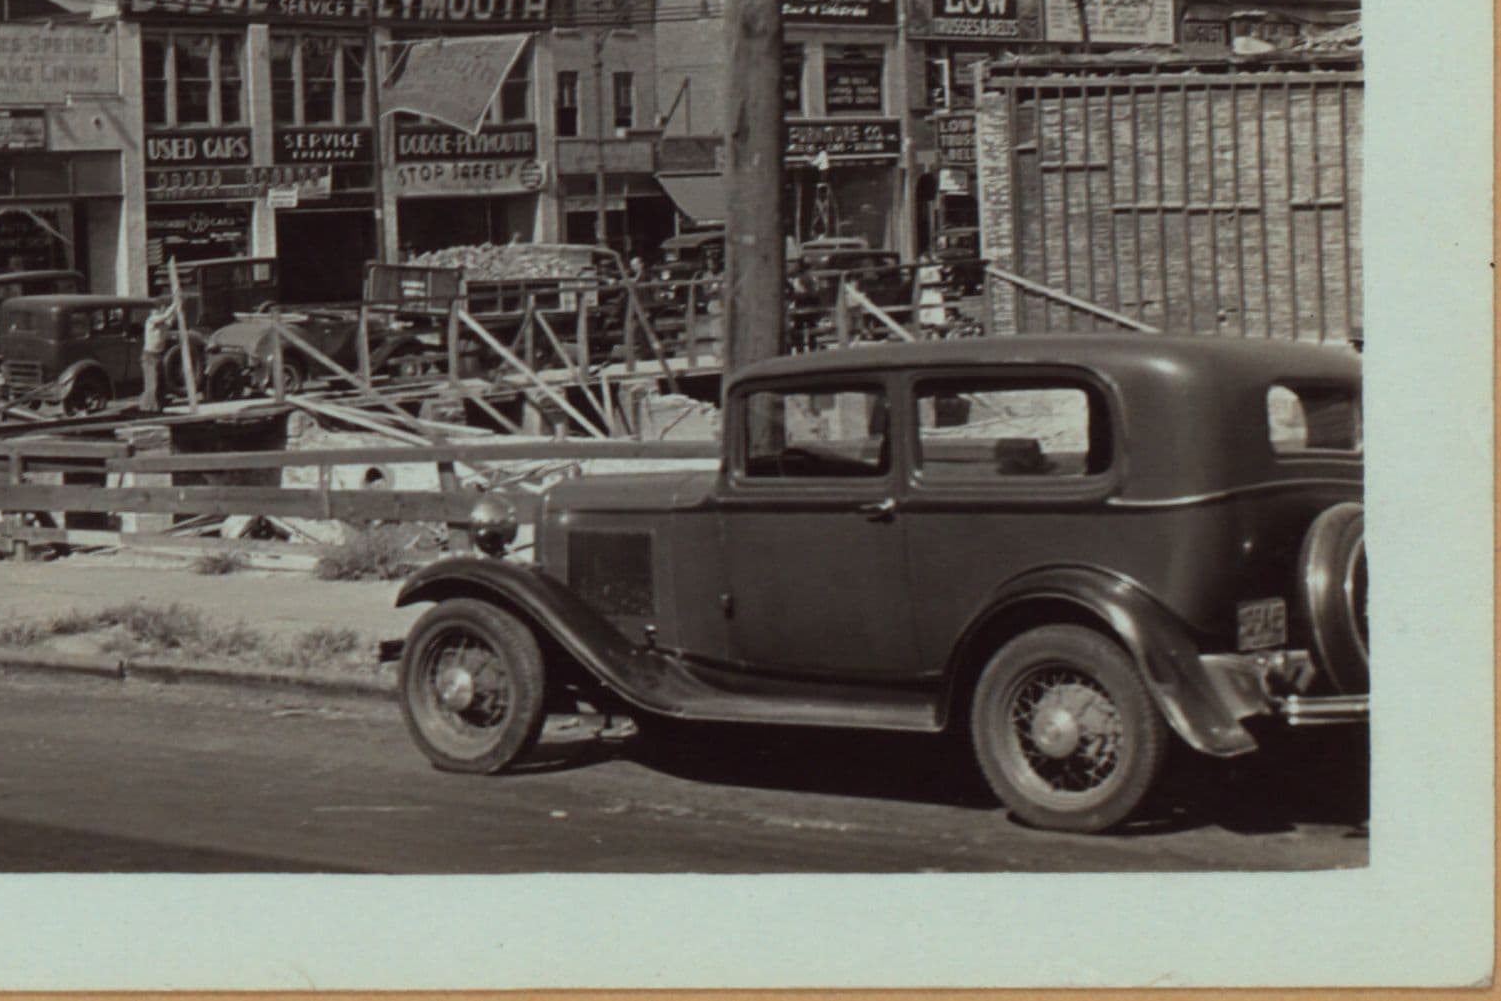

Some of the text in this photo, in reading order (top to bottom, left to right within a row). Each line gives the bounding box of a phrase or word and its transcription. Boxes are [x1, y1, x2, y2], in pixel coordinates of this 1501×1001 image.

[279, 0, 346, 17] SERVICE
[147, 136, 250, 160] USED CARS
[283, 133, 364, 150] SERVICE
[397, 165, 444, 186] STOP
